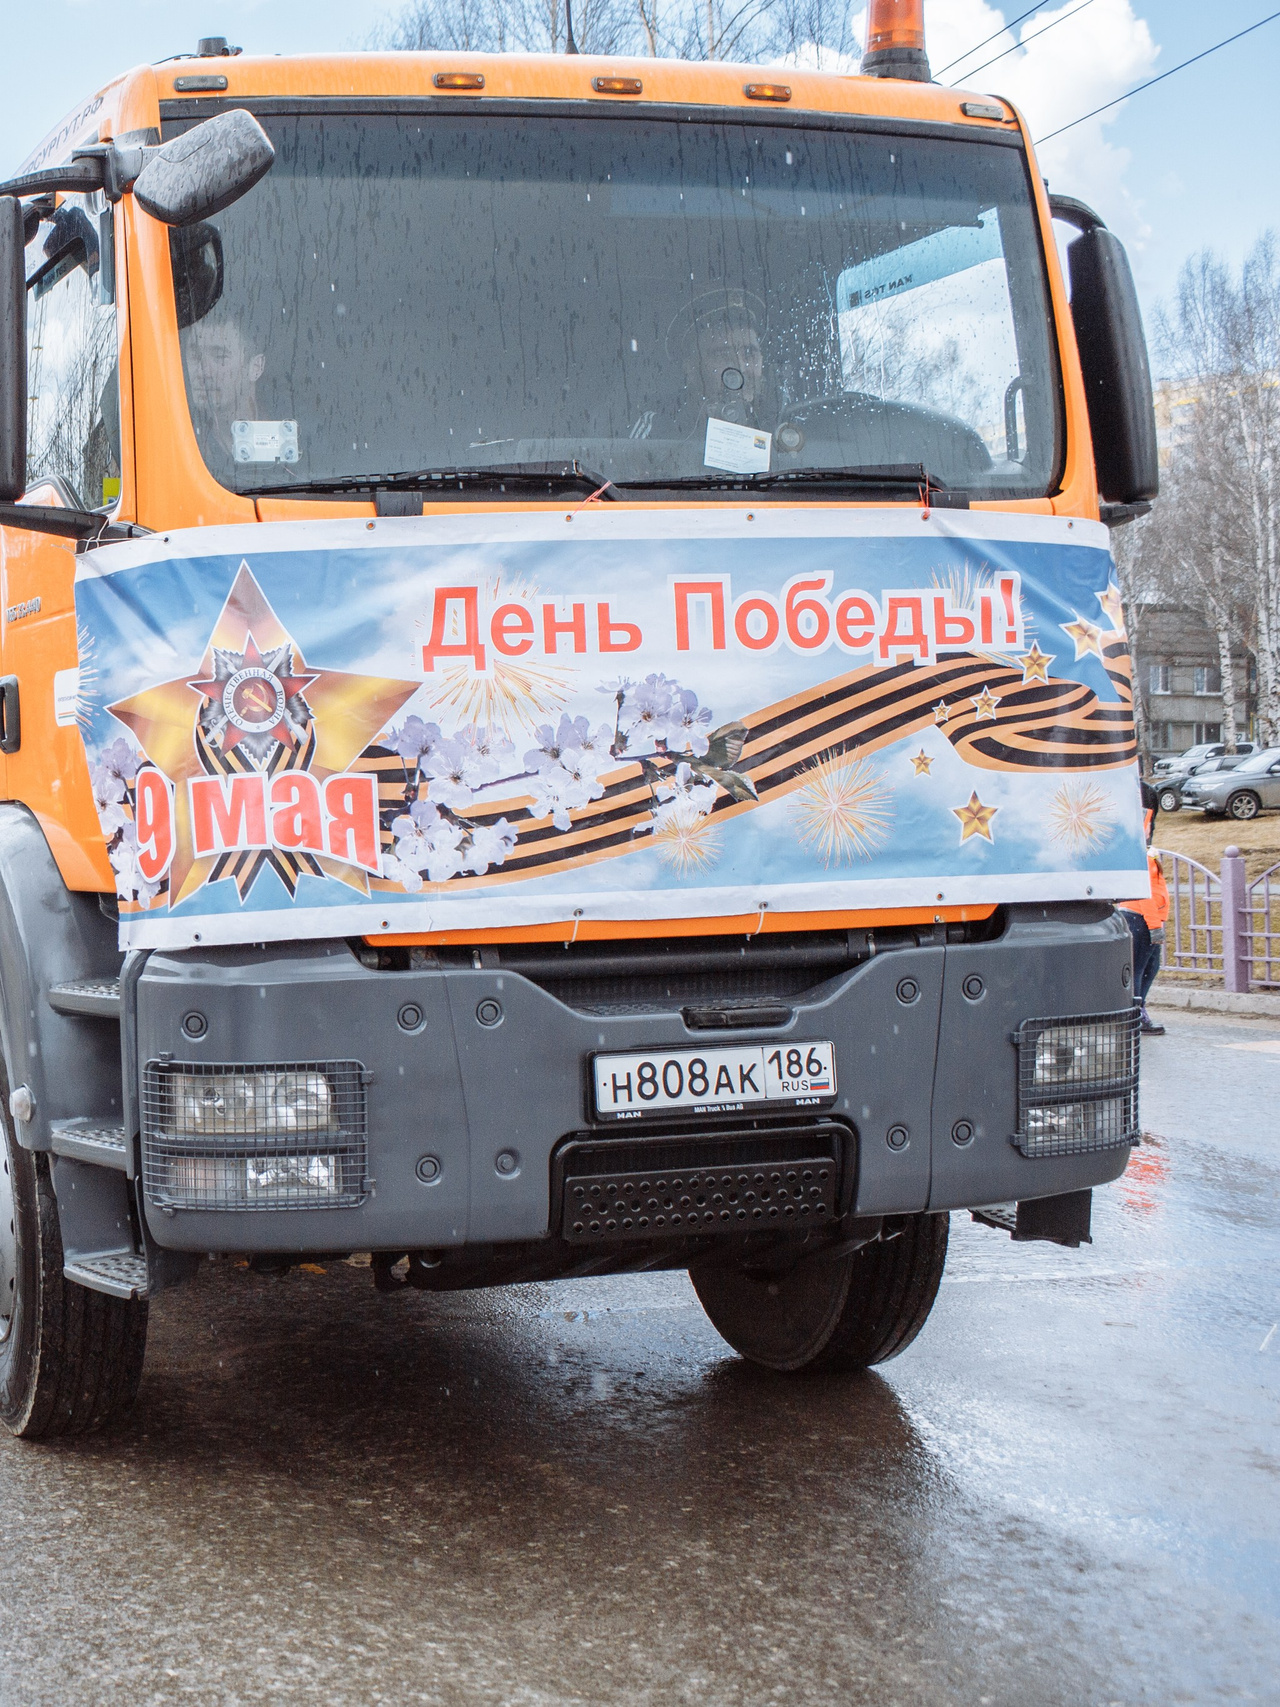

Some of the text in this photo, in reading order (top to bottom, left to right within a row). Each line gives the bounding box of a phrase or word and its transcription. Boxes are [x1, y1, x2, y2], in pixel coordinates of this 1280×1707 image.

[422, 577, 1019, 673] День Победы!
[224, 669, 273, 726] ОТЕЧЕСТВЕННАЯ
[137, 770, 171, 879] 9
[768, 1047, 821, 1080] 186
[782, 1080, 809, 1092] RUS
[795, 1097, 820, 1106] MAN
[616, 1110, 642, 1119] MAN
